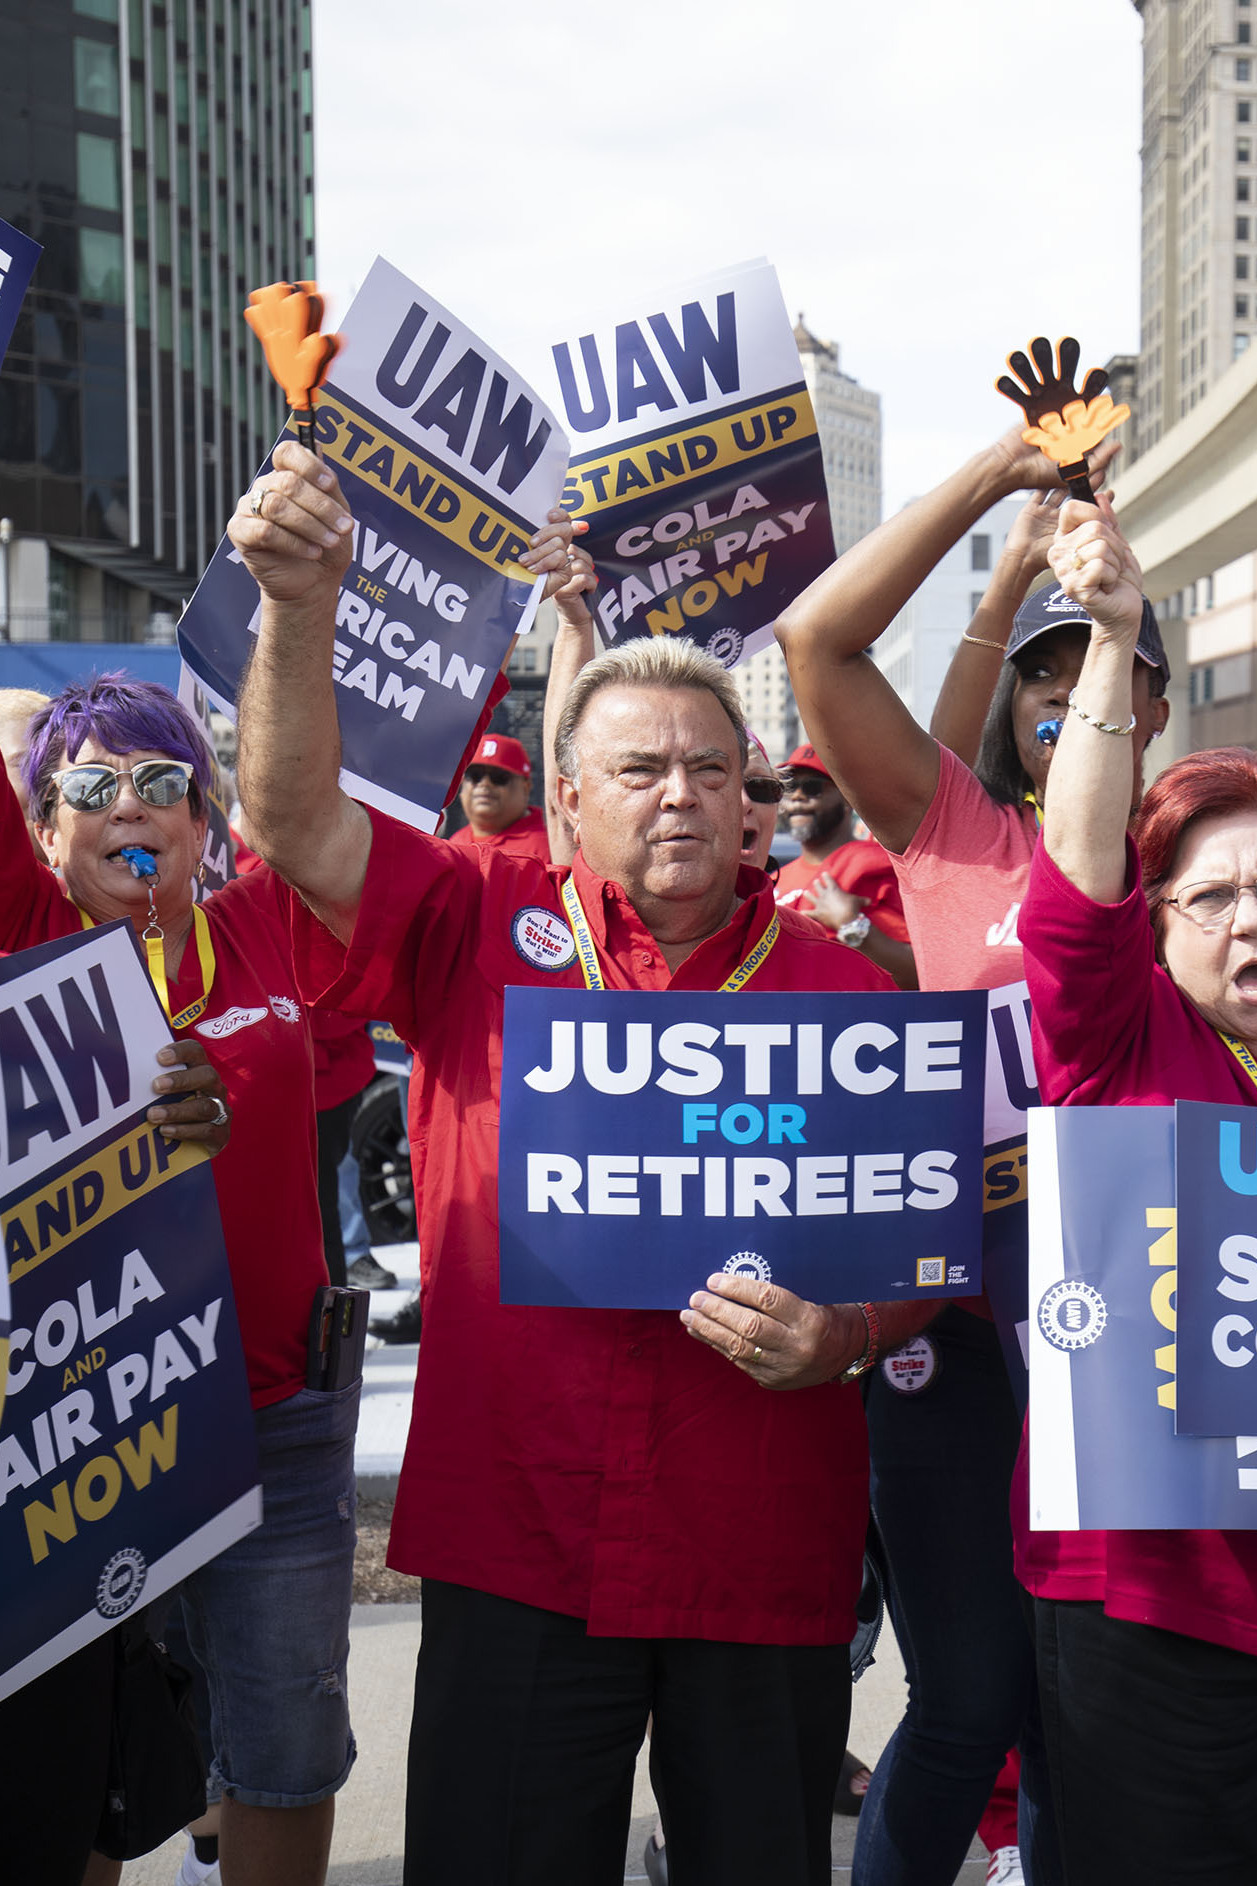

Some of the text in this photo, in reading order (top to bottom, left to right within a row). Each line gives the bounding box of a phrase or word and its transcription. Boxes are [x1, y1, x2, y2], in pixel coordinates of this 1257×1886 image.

[375, 302, 552, 496] UAW
[551, 291, 741, 434] UAW
[313, 403, 532, 571] STAND UP
[559, 406, 798, 512] STAND UP
[615, 484, 770, 558] COLA
[675, 530, 715, 554] AND
[351, 518, 470, 623] VING
[355, 574, 388, 604] THE
[597, 501, 818, 641] FAIR PAY
[645, 551, 769, 635] NOW
[524, 925, 563, 954] Strike
[526, 916, 544, 932] Don't
[543, 927, 560, 941] Want
[569, 902, 582, 927] THE
[577, 927, 603, 990] AMERICAN
[727, 916, 780, 990] A STRONG CONT
[173, 1004, 201, 1027] NITED
[212, 1010, 251, 1035] Ford
[0, 962, 131, 1166] AW
[522, 1020, 964, 1096] JUSTICE
[682, 1103, 807, 1145] FOR
[7, 1126, 182, 1275] AND UP
[527, 1150, 959, 1218] RETIREES
[5, 1248, 166, 1397] COLA
[1066, 1300, 1082, 1329] UAW
[0, 1297, 224, 1508] AIR PAY
[62, 1345, 107, 1392] AND
[22, 1403, 179, 1566] NOW
